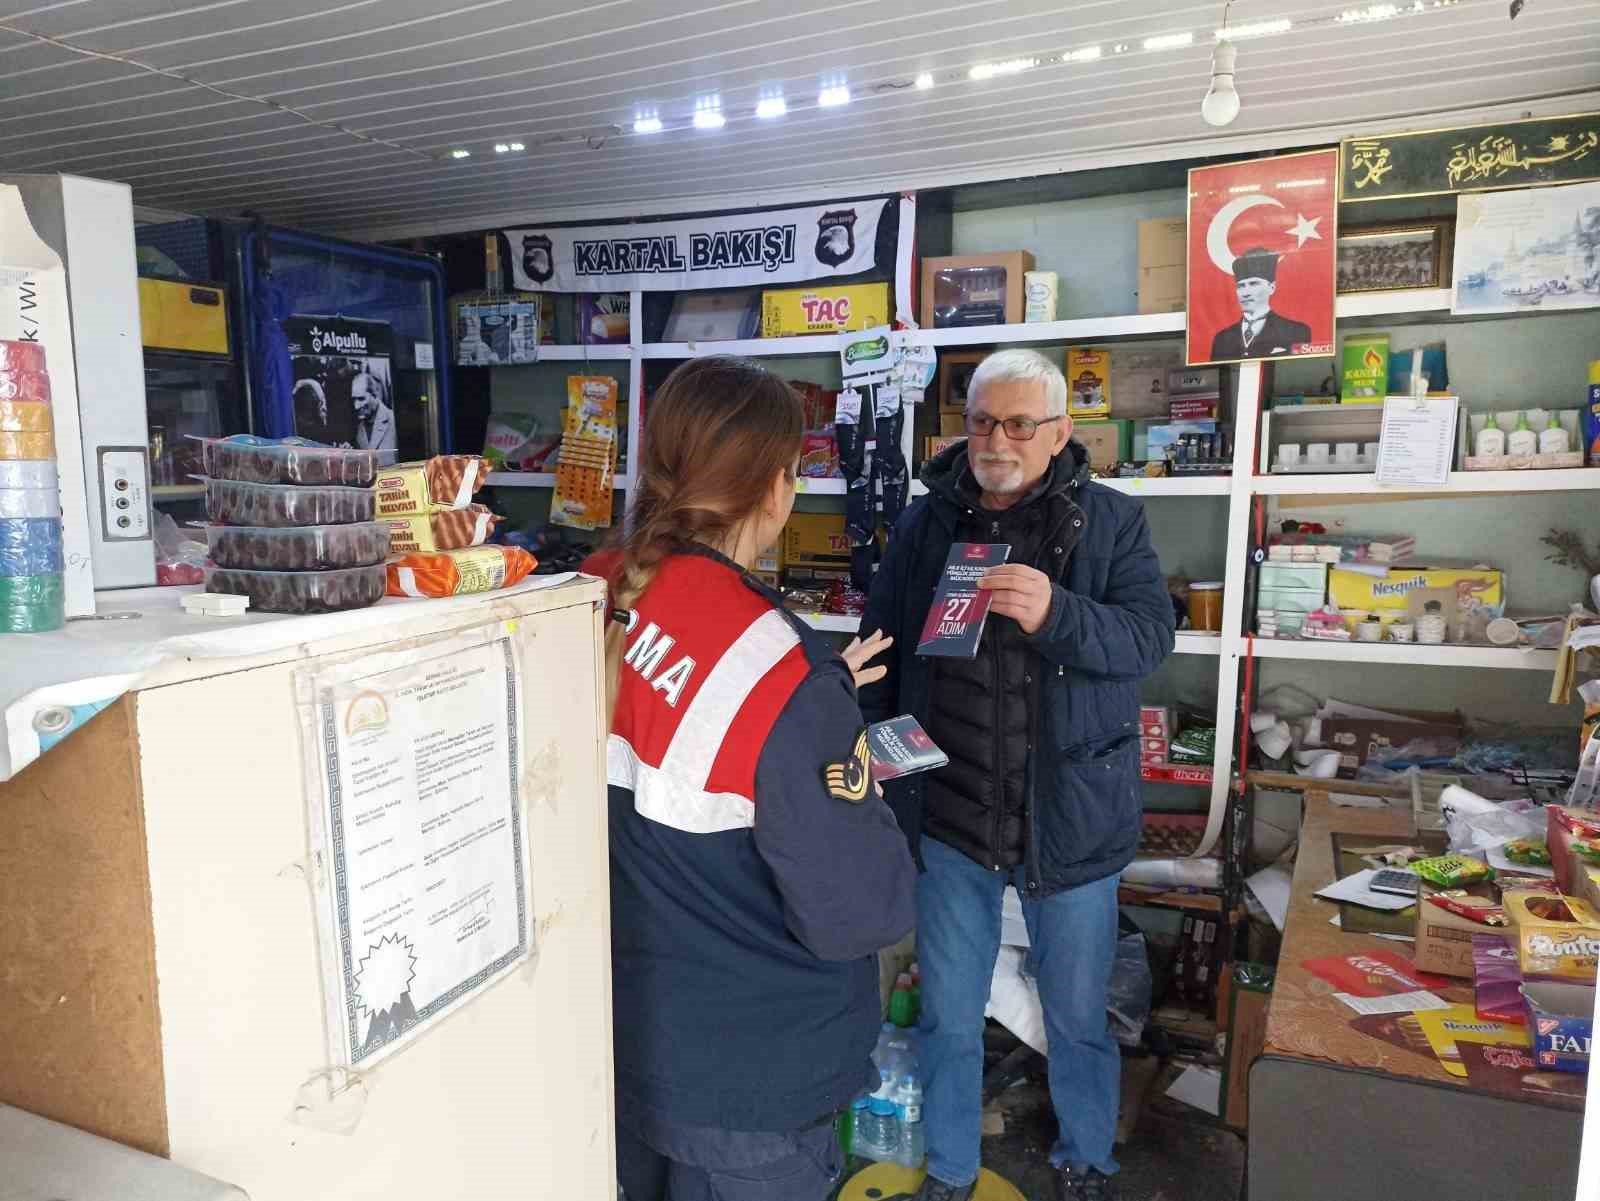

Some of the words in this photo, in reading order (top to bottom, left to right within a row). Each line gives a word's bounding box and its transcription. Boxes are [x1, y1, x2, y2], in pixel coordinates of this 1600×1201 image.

[573, 236, 686, 275] KARTAL
[690, 224, 796, 272] BAKIŞI
[802, 298, 850, 325] TAÇ
[323, 331, 366, 351] Alpullu
[1372, 576, 1427, 597] Nesquik
[943, 599, 971, 621] 27
[936, 622, 966, 635] ADIM
